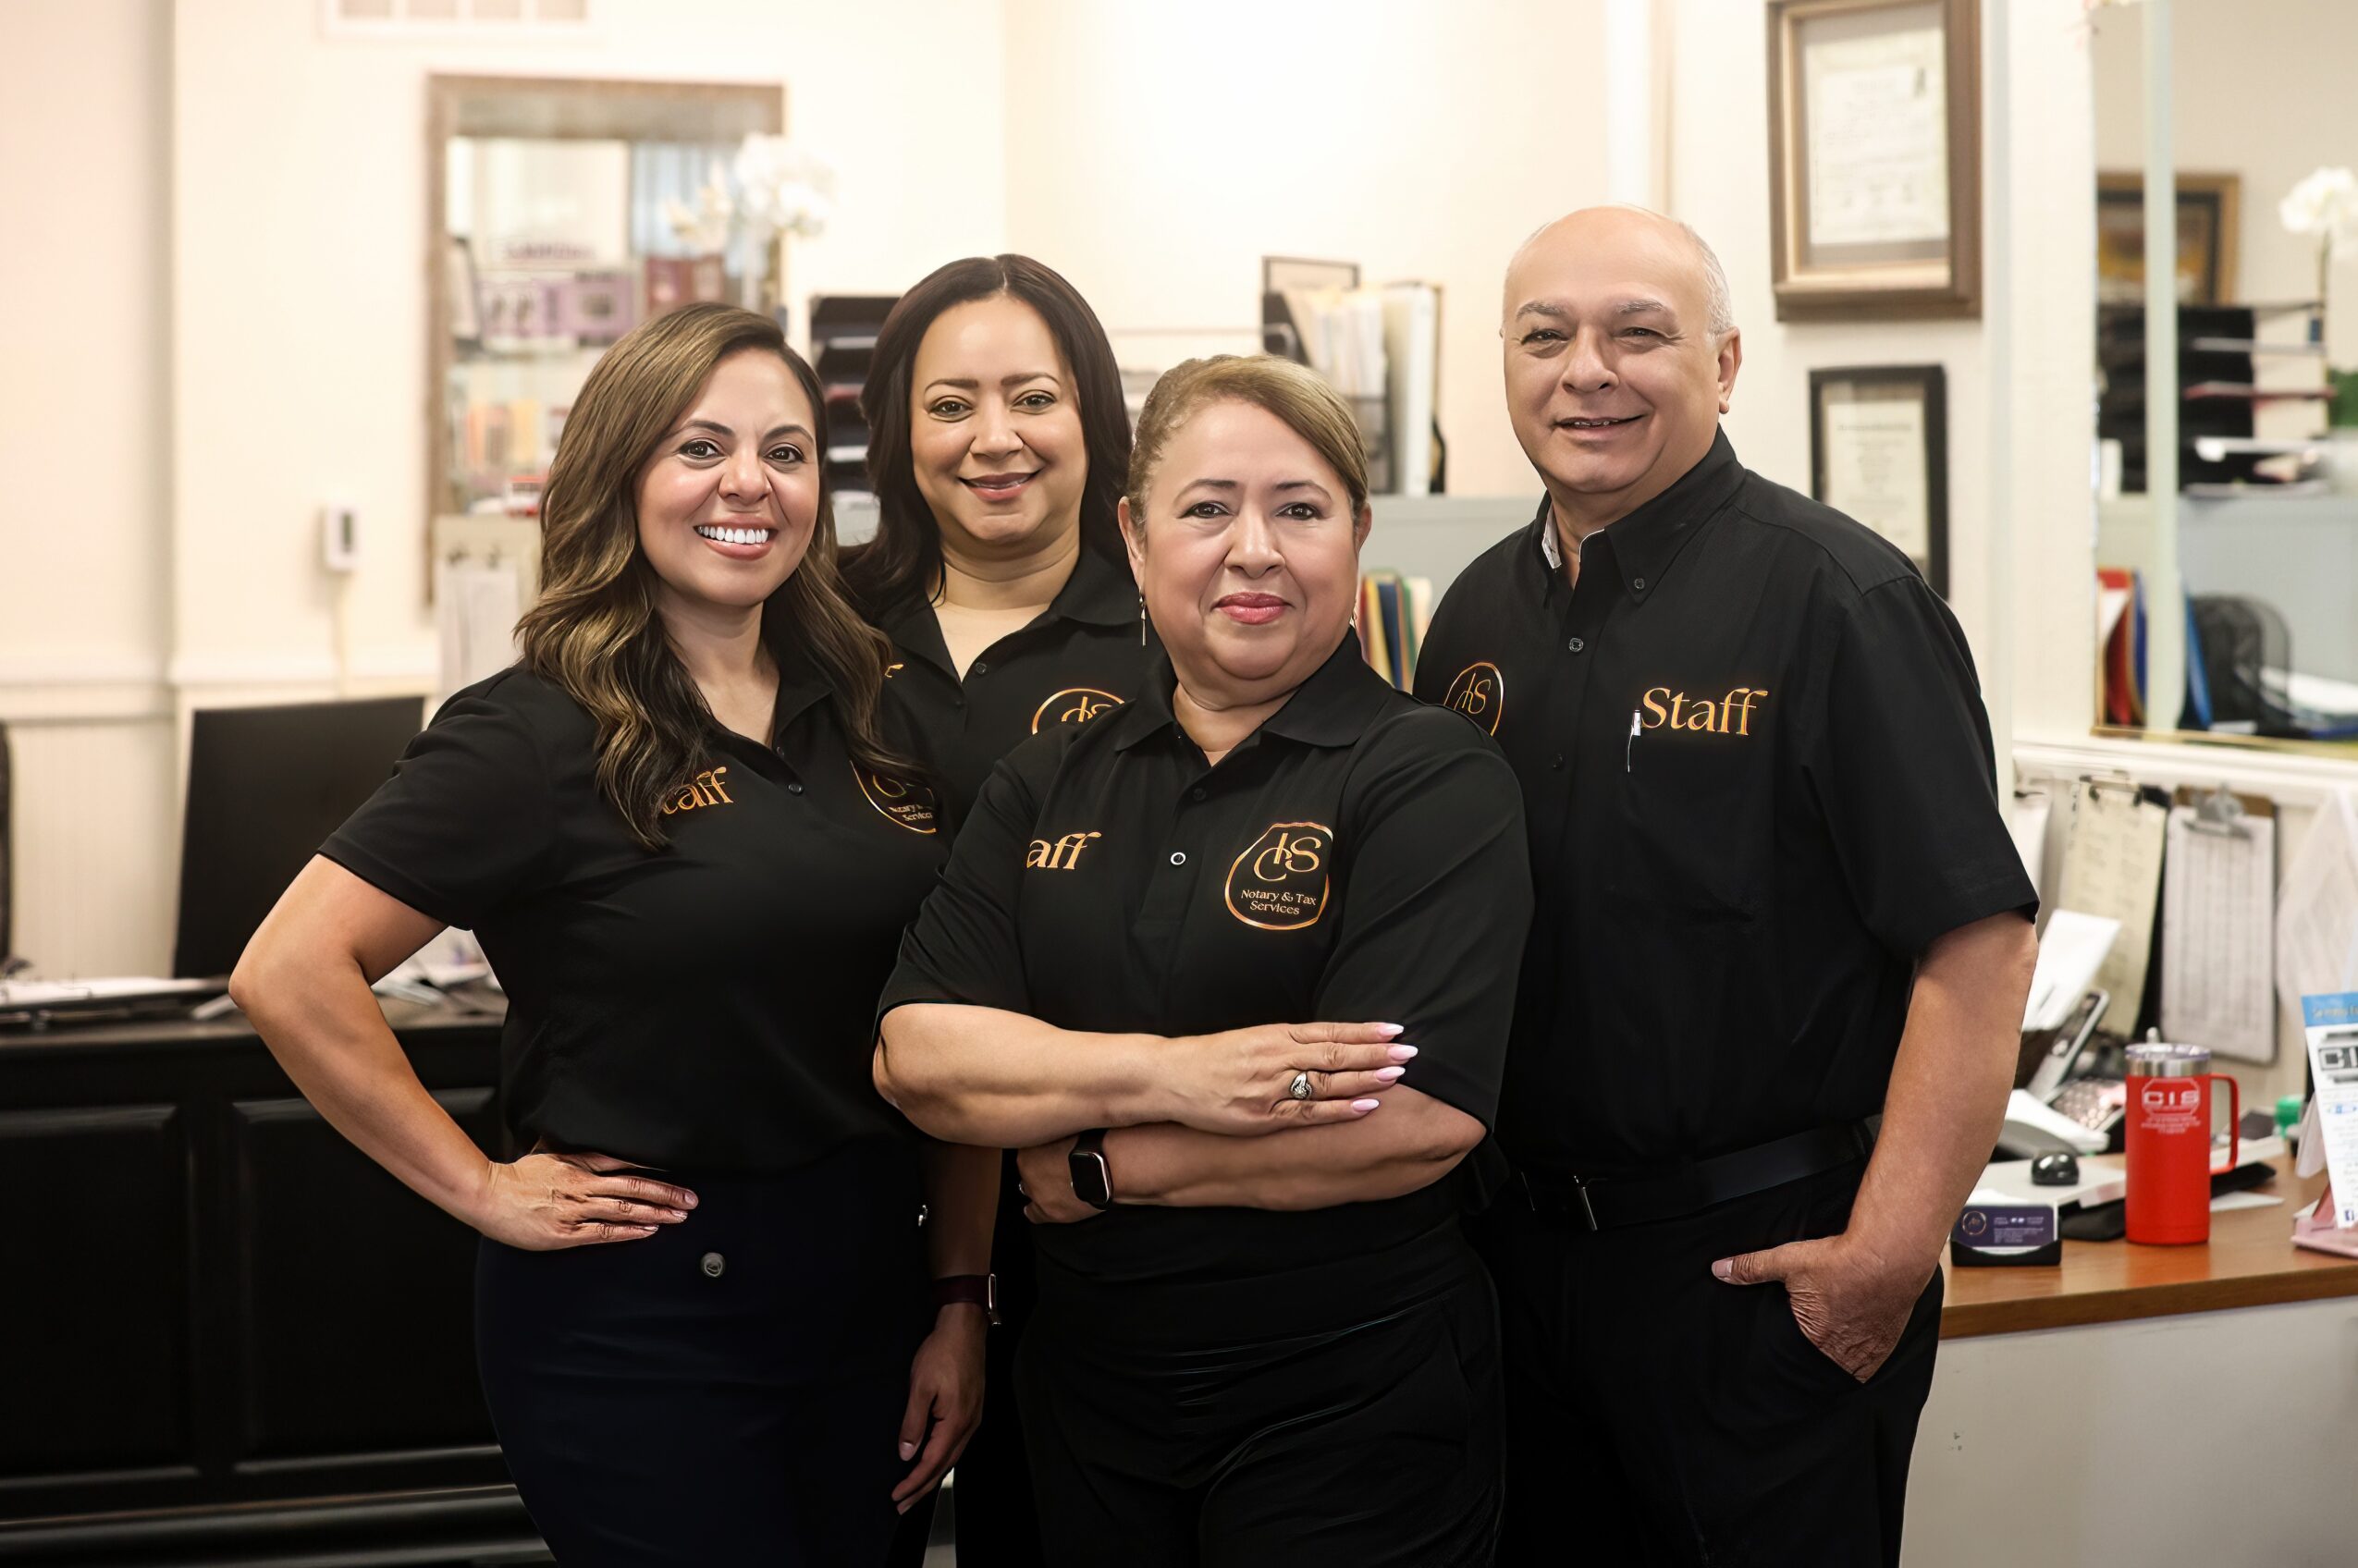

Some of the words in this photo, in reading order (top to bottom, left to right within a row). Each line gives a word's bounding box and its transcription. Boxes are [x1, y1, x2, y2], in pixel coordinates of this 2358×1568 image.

[1641, 687, 1769, 736] Staff
[1241, 889, 1279, 901] Notary
[1281, 891, 1294, 902] &
[1296, 893, 1317, 905] Tax
[1249, 900, 1300, 915] Services
